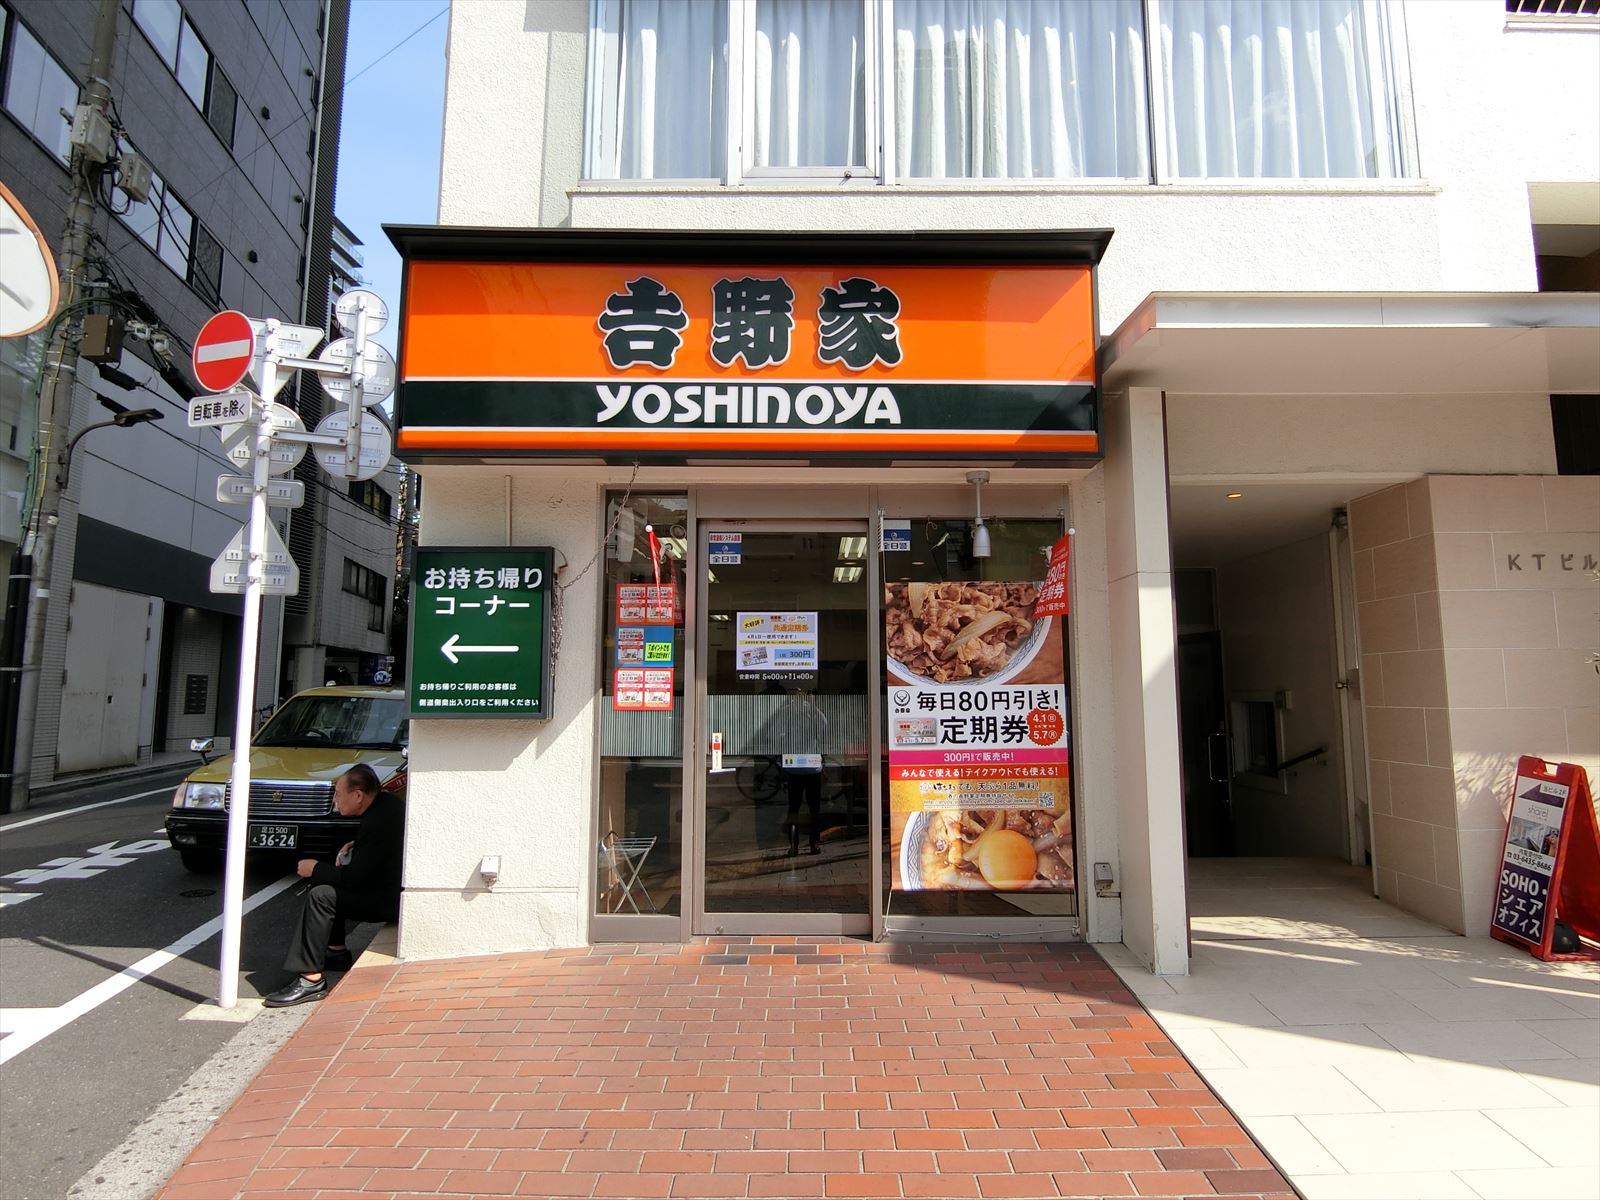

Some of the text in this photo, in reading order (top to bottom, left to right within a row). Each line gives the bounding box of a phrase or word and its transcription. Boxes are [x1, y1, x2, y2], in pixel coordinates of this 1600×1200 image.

[193, 400, 245, 421] 自転車を除く
[596, 384, 901, 425] YOSHINOYA
[424, 567, 543, 590] お持ち帰り
[435, 595, 530, 616] コーナー
[789, 650, 811, 658] 300円
[419, 682, 517, 691] お持ち帰りご利用のお客様は
[917, 689, 1059, 712] 毎日80円引き!
[940, 715, 1029, 745] 定期券
[259, 833, 295, 847] 36-24
[275, 826, 288, 834] 500
[1513, 854, 1551, 871] 03-6435-8686
[1502, 888, 1543, 915] シェア
[1498, 907, 1540, 938] オフィス
